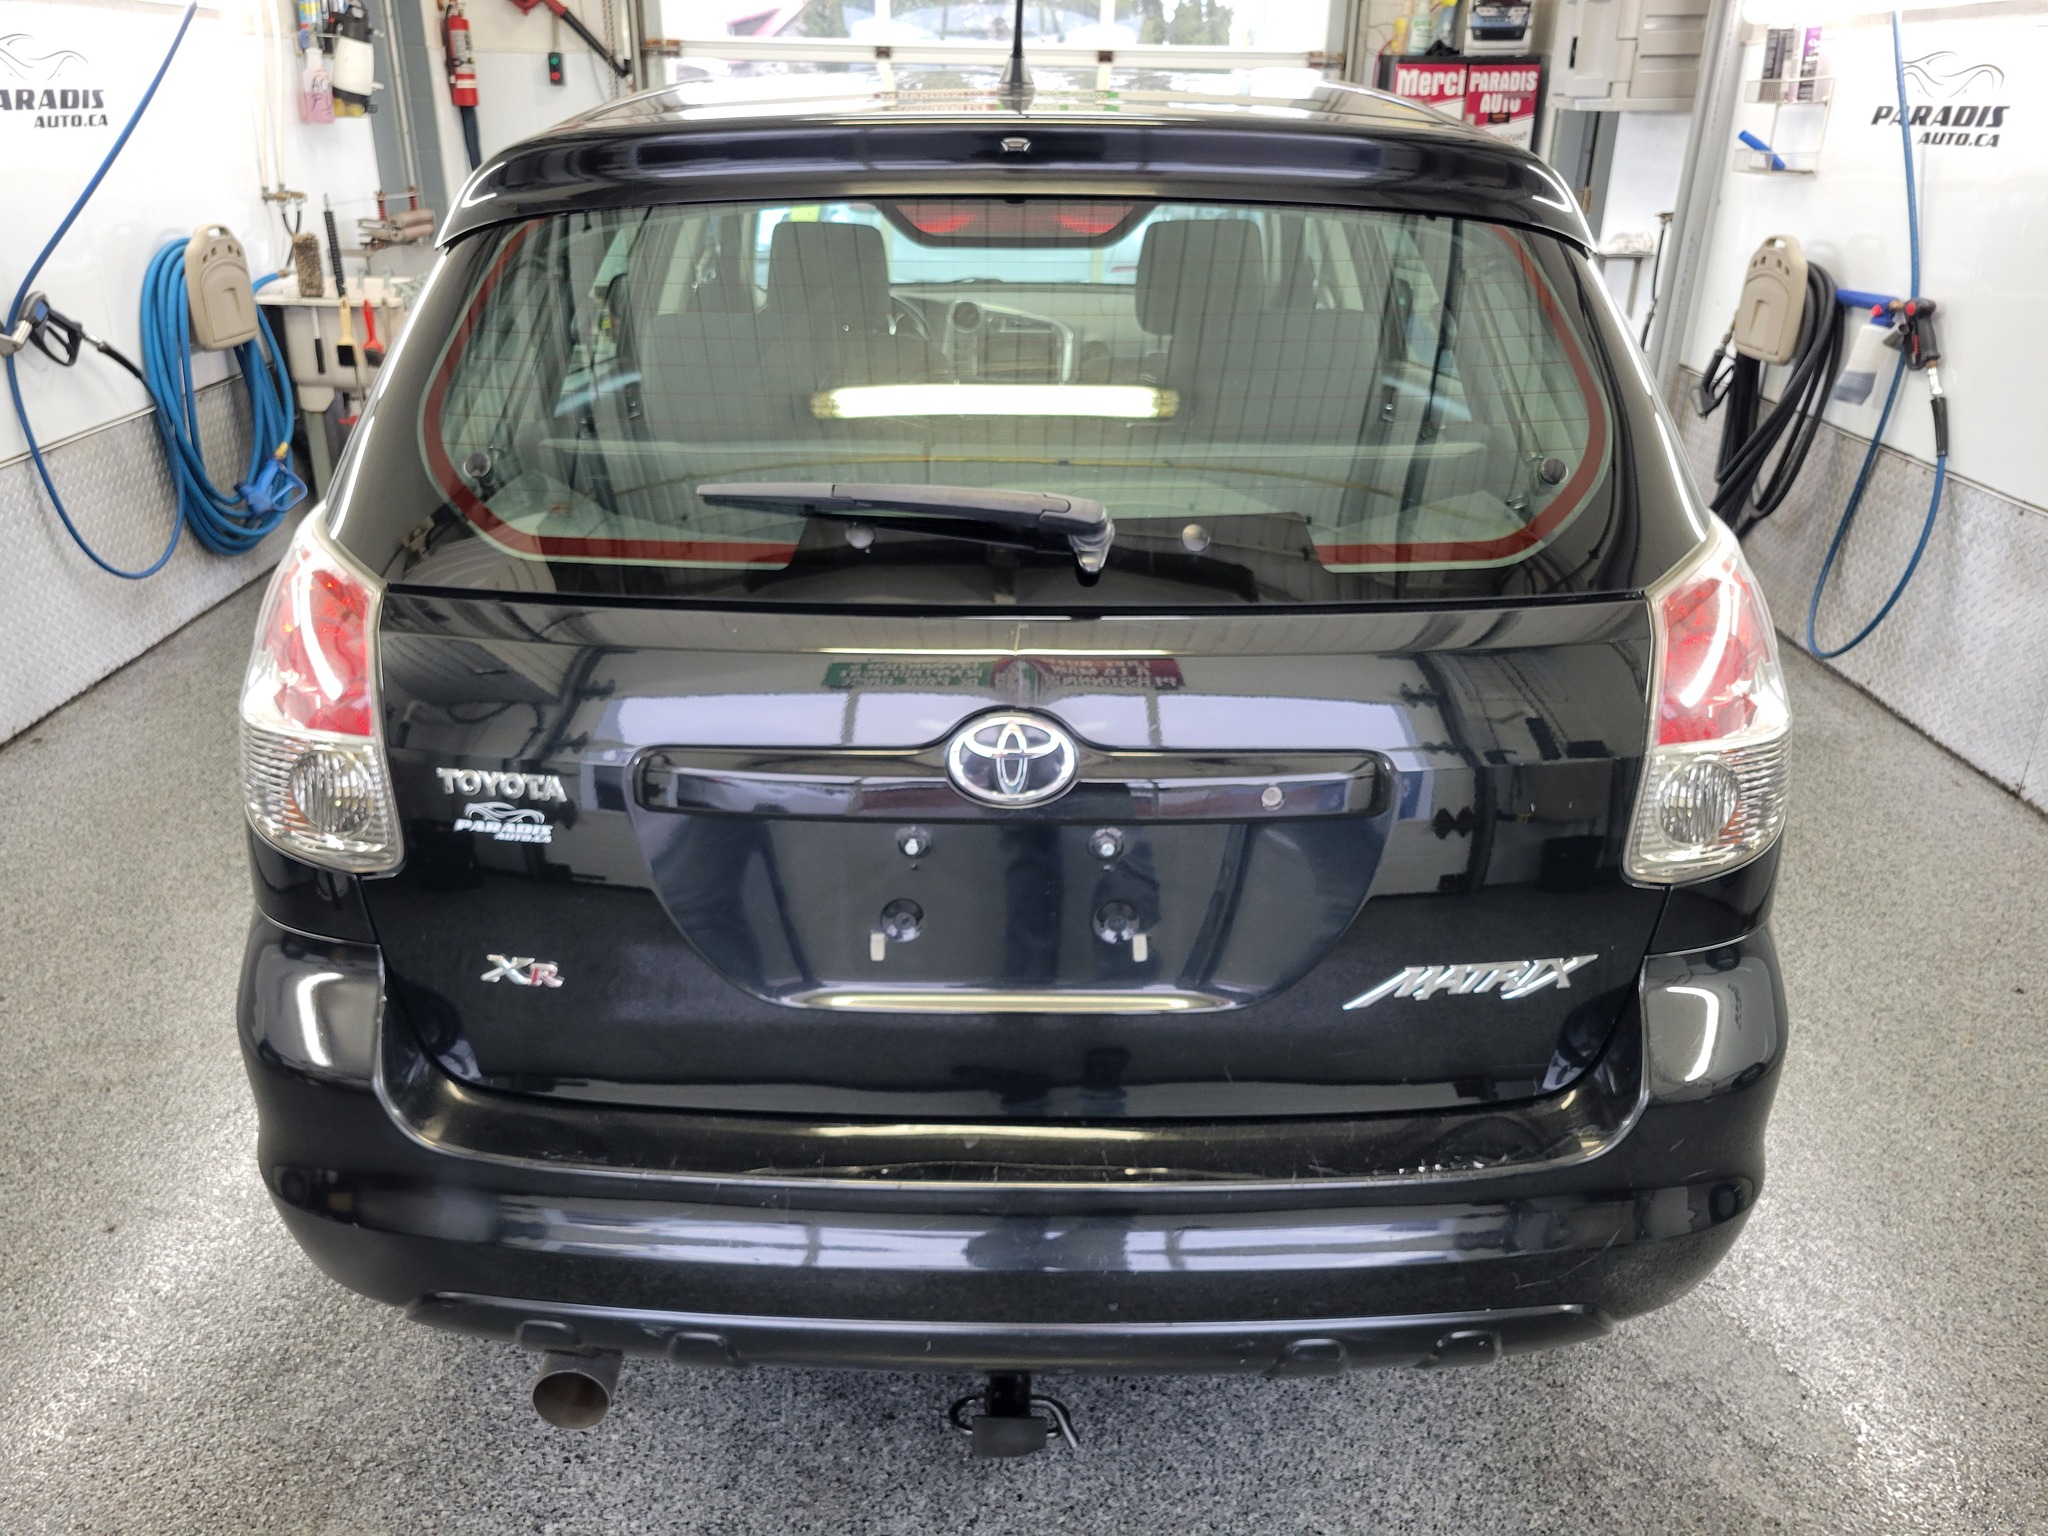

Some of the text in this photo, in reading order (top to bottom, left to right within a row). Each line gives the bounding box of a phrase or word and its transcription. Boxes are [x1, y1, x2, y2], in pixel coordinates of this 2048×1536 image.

[1395, 68, 1467, 97] Merci
[1469, 70, 1538, 93] PARADIS
[0, 89, 104, 110] ARADIS
[34, 114, 108, 129] AUTO.CA
[1917, 132, 2000, 148] AUTO.CA
[435, 767, 568, 803] TOYOTA
[453, 818, 554, 835] PARADIS
[480, 953, 566, 989] XR
[1342, 953, 1600, 1010] MATRIX
